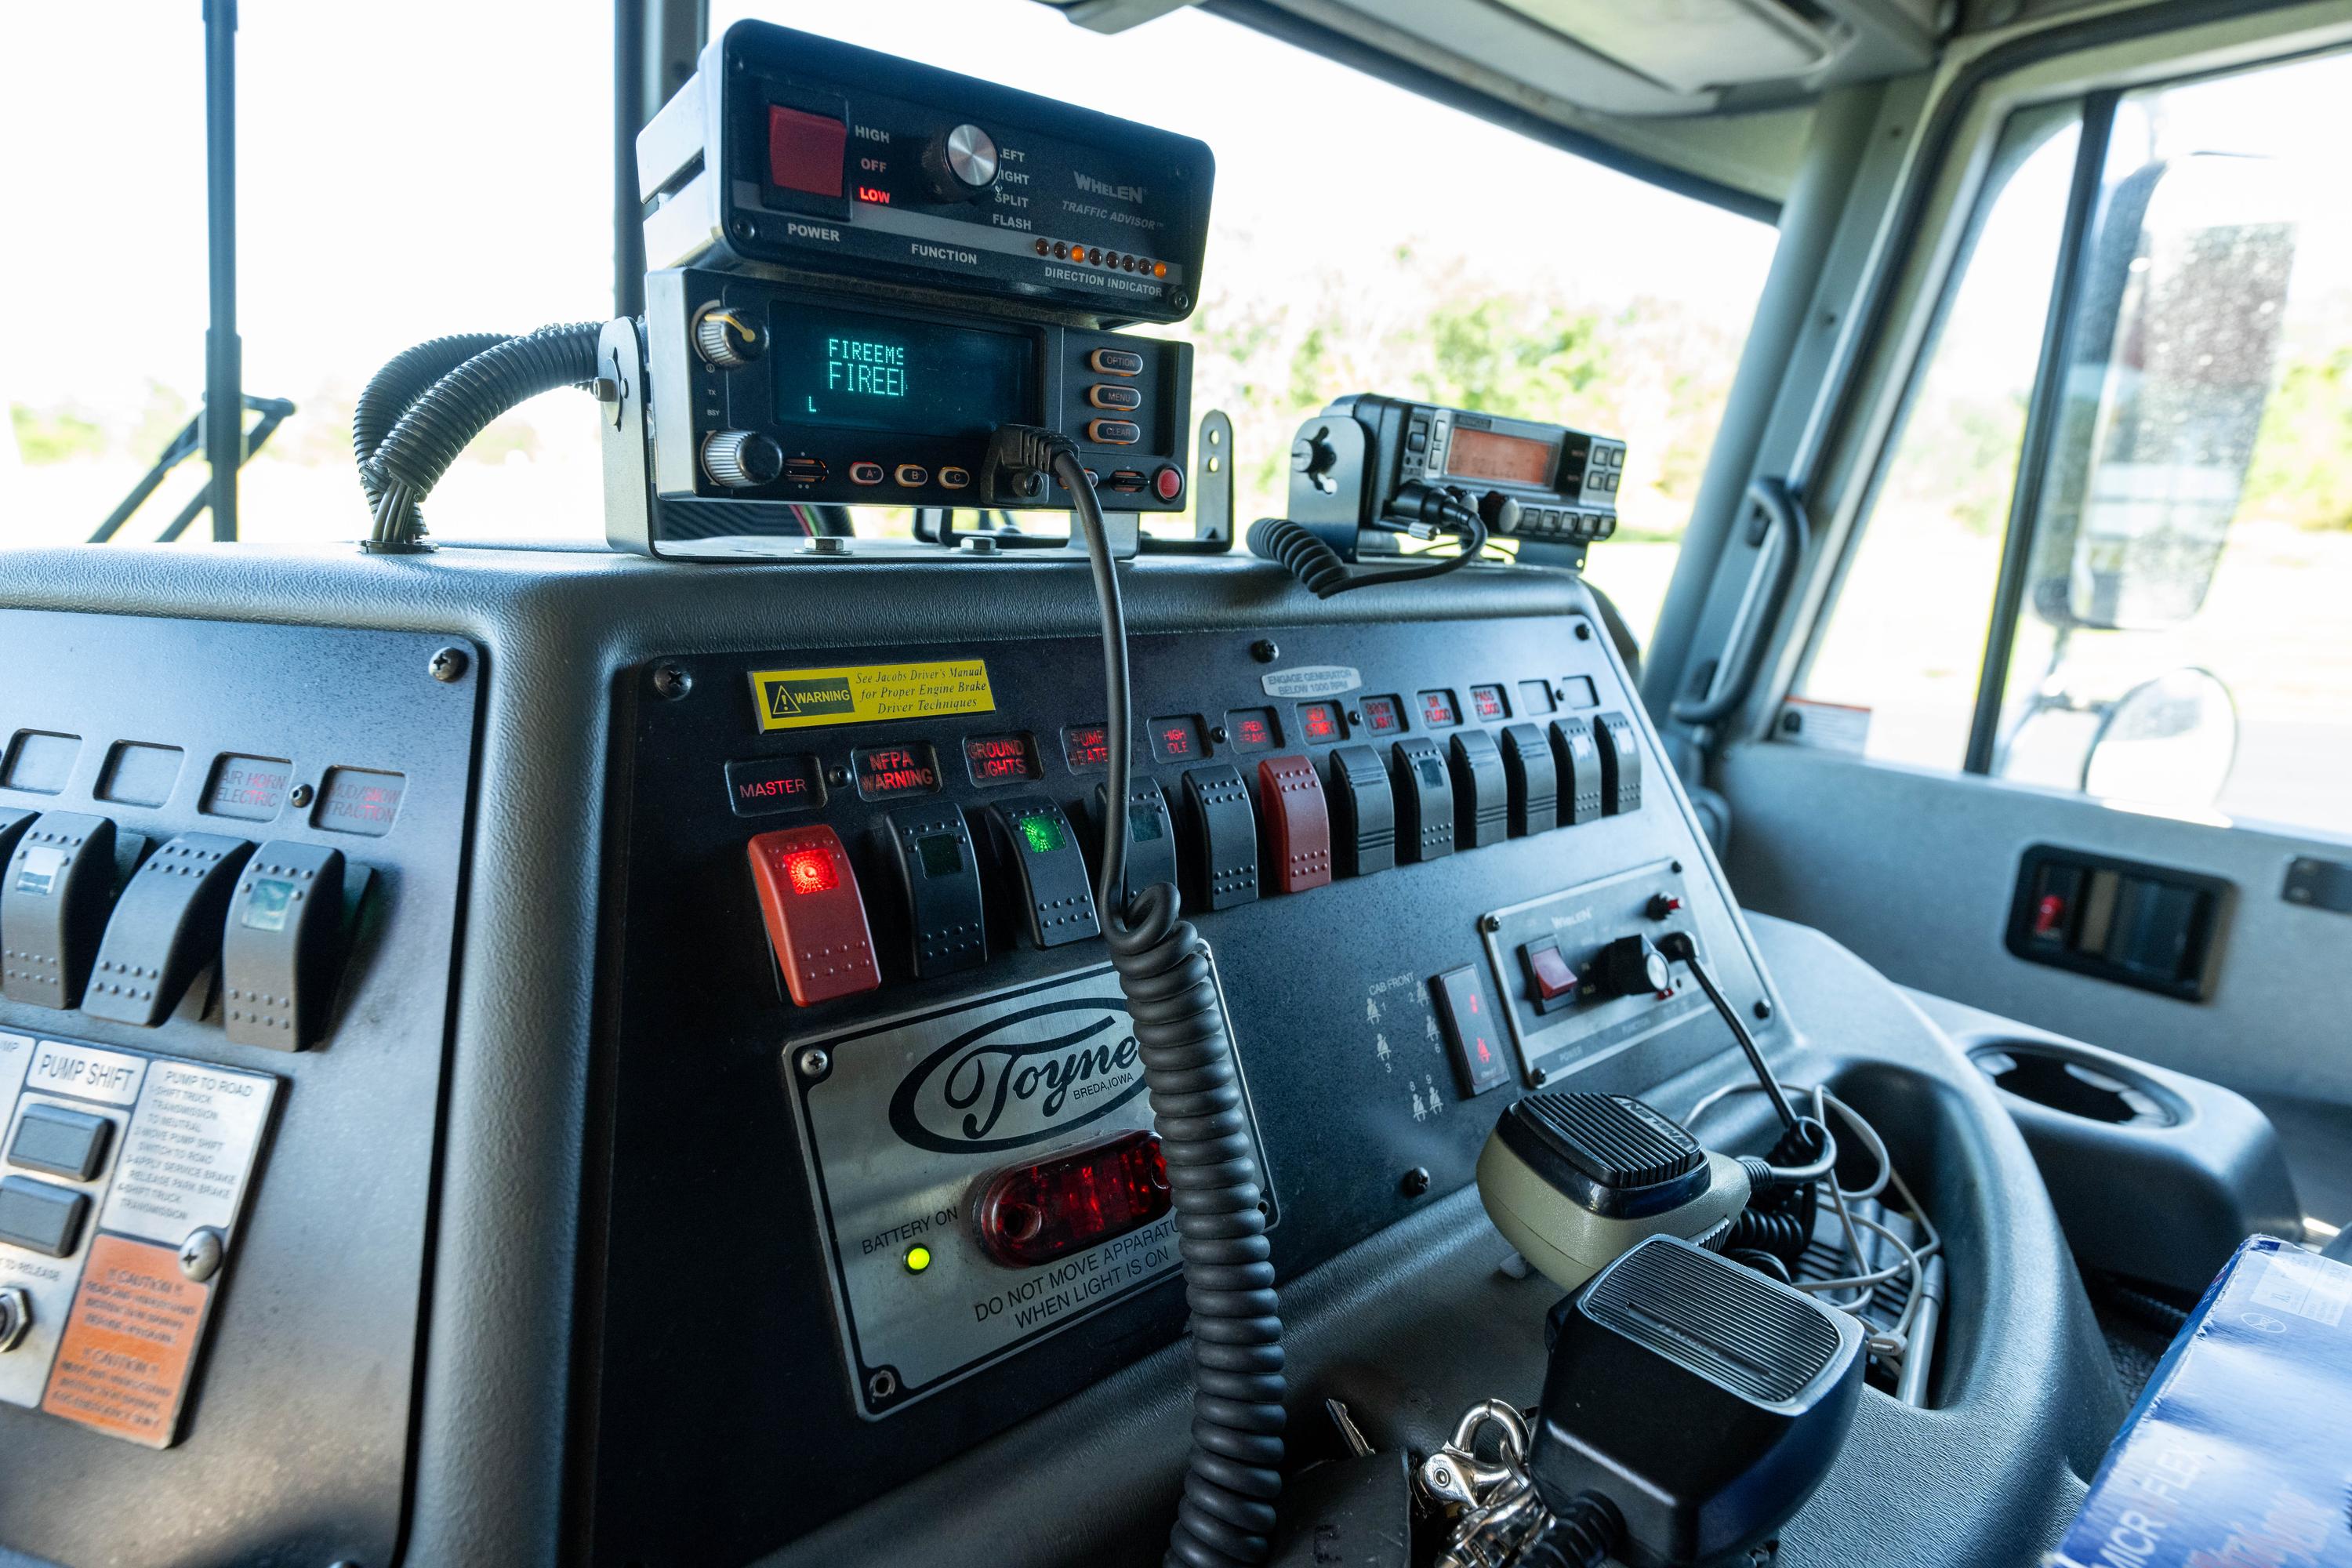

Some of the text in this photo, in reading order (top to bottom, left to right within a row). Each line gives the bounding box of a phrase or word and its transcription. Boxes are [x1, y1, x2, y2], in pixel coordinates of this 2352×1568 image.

[855, 125, 890, 143] HIGH
[1000, 147, 1025, 162] EFT
[861, 158, 887, 172] OFF
[998, 169, 1030, 185] IGHT
[859, 187, 891, 204] LOW
[1073, 171, 1143, 204] WHELEN
[994, 193, 1029, 208] SPLIT
[1062, 200, 1108, 219] TRAFFIC
[993, 213, 1032, 231] FLASH
[787, 223, 840, 242] POWER
[911, 243, 978, 265] FUNCTION
[1044, 267, 1163, 297] DIRECTION INDICATOR
[829, 338, 904, 365] FIREEMS
[1106, 355, 1136, 368] OPTION
[829, 361, 904, 397] FIREE
[1108, 392, 1131, 402] MENU
[1106, 426, 1131, 437] CLEAR
[866, 469, 873, 478] A
[912, 470, 919, 480] B
[953, 473, 960, 482] C
[855, 666, 983, 684] See Jacobs Driver's Manual
[1268, 670, 1352, 684] ENGAGE GENERATOR
[794, 688, 851, 704] WARNING
[859, 681, 986, 703] for Proper Engine Brake
[1278, 684, 1308, 695] BELOW
[1473, 691, 1495, 702] PASS
[877, 698, 978, 714] Driver Techniques
[1476, 703, 1501, 717] FLOOD
[1425, 709, 1451, 722] FLOOD
[1071, 729, 1105, 746] PUMP
[1163, 728, 1187, 741] HIGH
[1305, 720, 1336, 738] START
[967, 739, 1025, 760] GROUND
[1069, 747, 1109, 766] HEATE
[1167, 741, 1190, 755] IDLE
[868, 750, 916, 771] NFPA
[973, 758, 1027, 779] LIGHTS
[222, 770, 287, 790] AIR HORN
[739, 778, 807, 798] MASTER
[860, 768, 934, 792] WARNING
[216, 787, 278, 807] ELECTRIC
[326, 800, 394, 823] TRACTION
[1368, 972, 1414, 996] CAB FRONT
[1381, 1002, 1387, 1011] 1
[1407, 992, 1414, 1003] 2
[1434, 1044, 1441, 1054] 6
[38, 1054, 135, 1091] PUMP SHIFT
[944, 1014, 1138, 1140] Toyne
[1385, 1062, 1392, 1074] 3
[164, 1070, 254, 1097] PUMP TO ROAD
[1409, 1081, 1416, 1091] 8
[1425, 1074, 1432, 1084] 9
[861, 1206, 959, 1254] BATTERY ON
[975, 1218, 1179, 1323] DO NOT MOVE APPARATU
[1014, 1246, 1170, 1329] WHEN LIGHT IS ON
